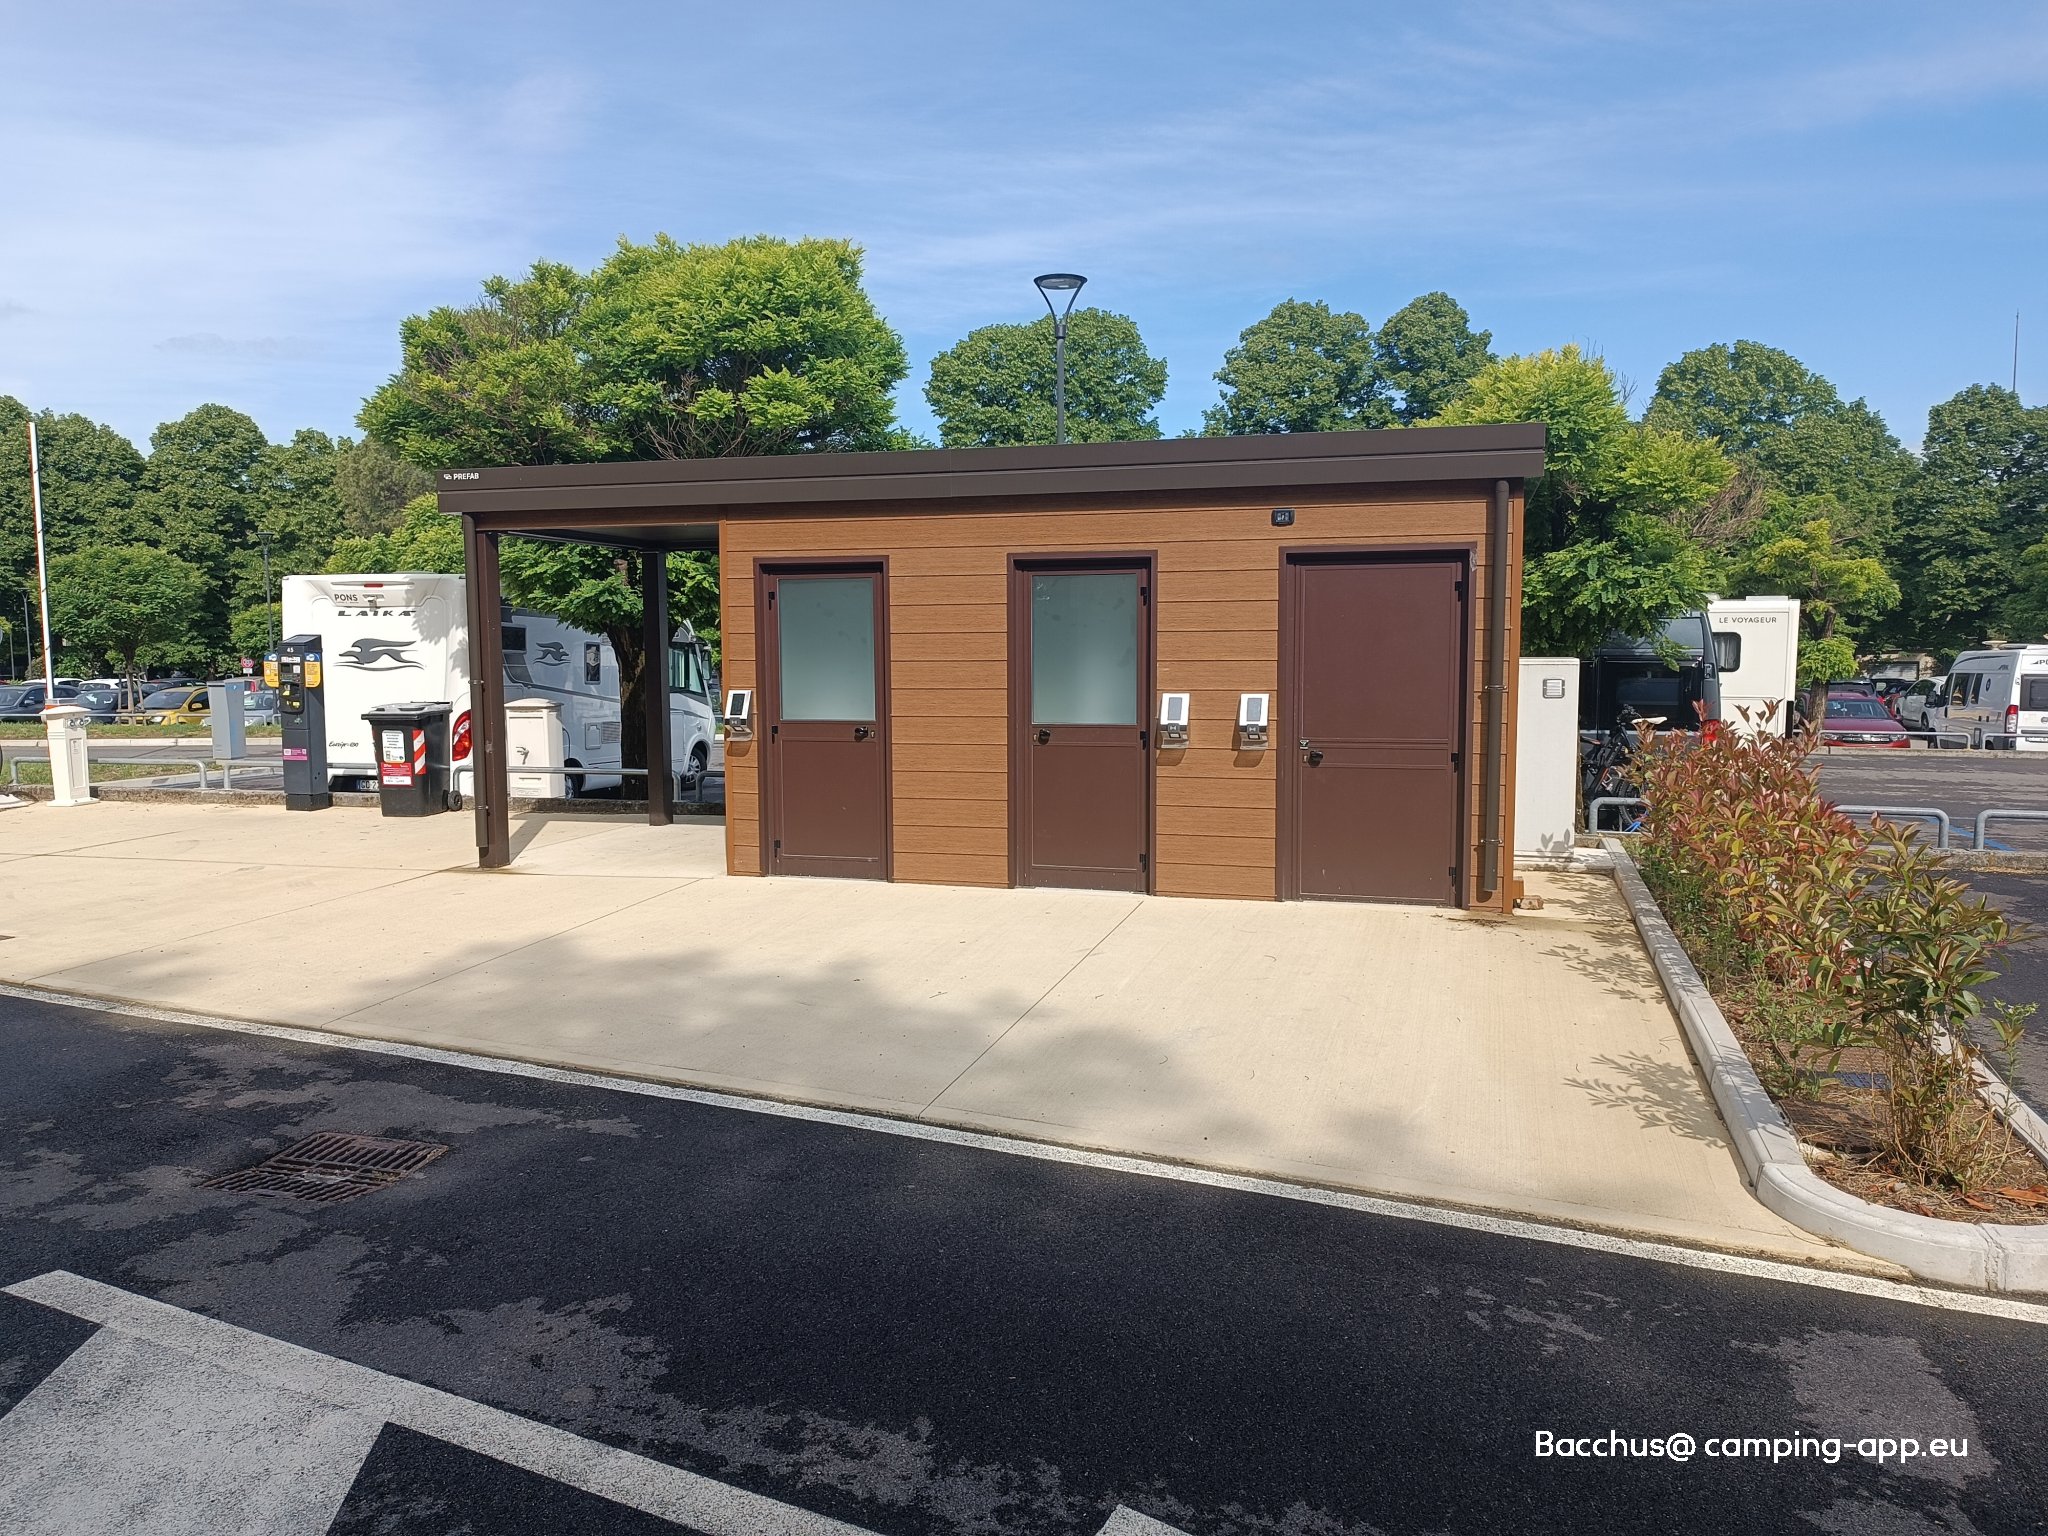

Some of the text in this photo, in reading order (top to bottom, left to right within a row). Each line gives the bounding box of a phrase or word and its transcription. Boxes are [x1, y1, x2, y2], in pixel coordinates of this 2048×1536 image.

[453, 472, 480, 480] PREFAB
[334, 593, 358, 601] PONS
[1732, 616, 1777, 624] VOYAGEUR
